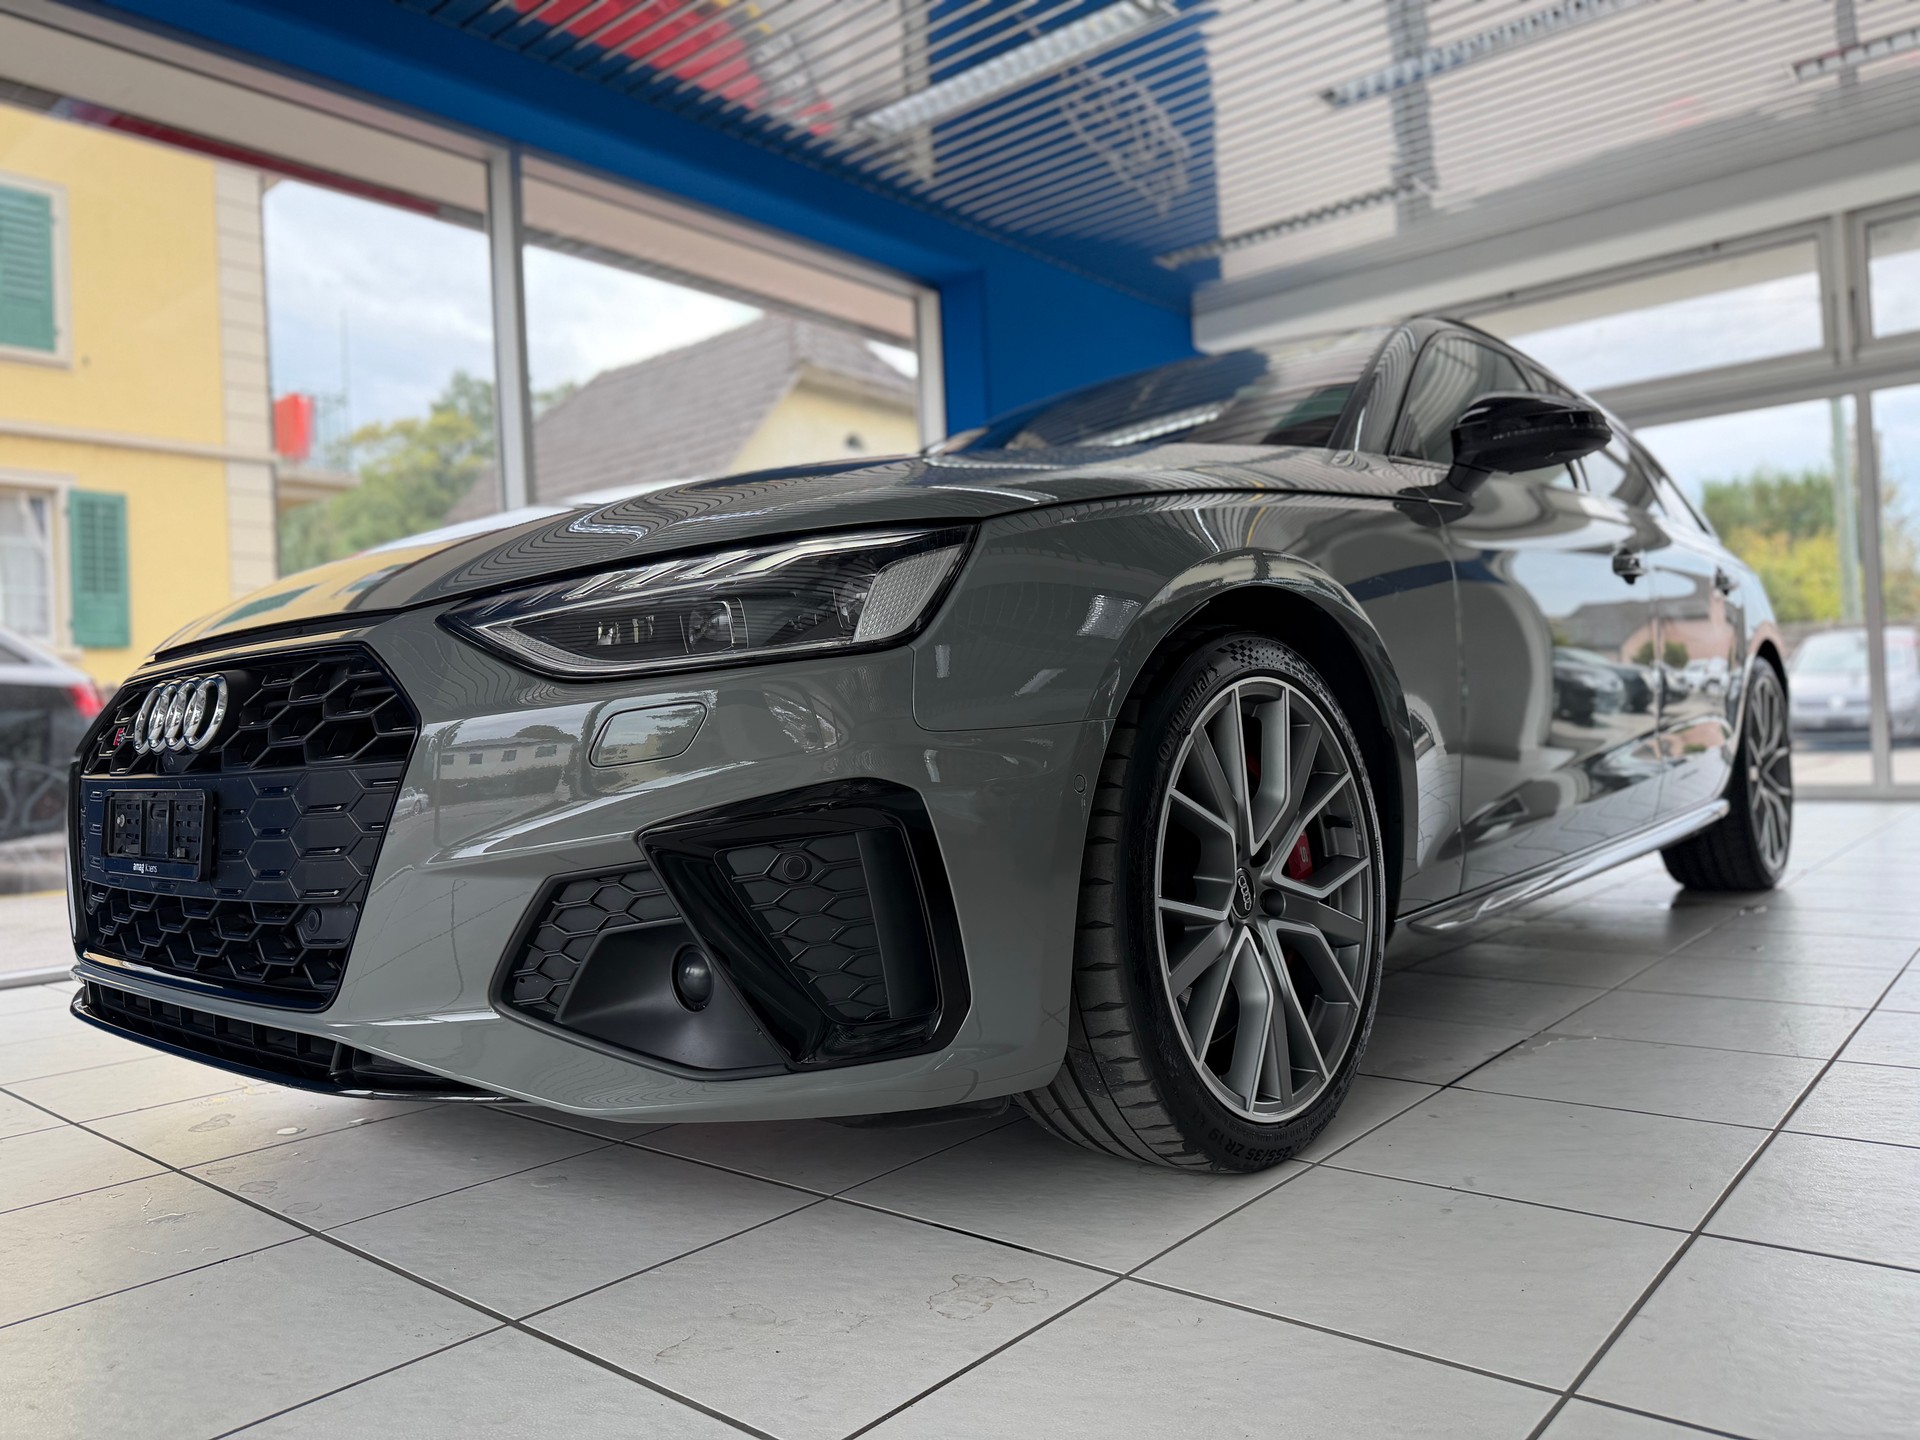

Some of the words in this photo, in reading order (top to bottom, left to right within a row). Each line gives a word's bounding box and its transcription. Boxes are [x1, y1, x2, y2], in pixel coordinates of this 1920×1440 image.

[1208, 1127, 1225, 1146] 19
[1224, 1139, 1245, 1158] ZR
[1244, 1146, 1292, 1162] 255/35
